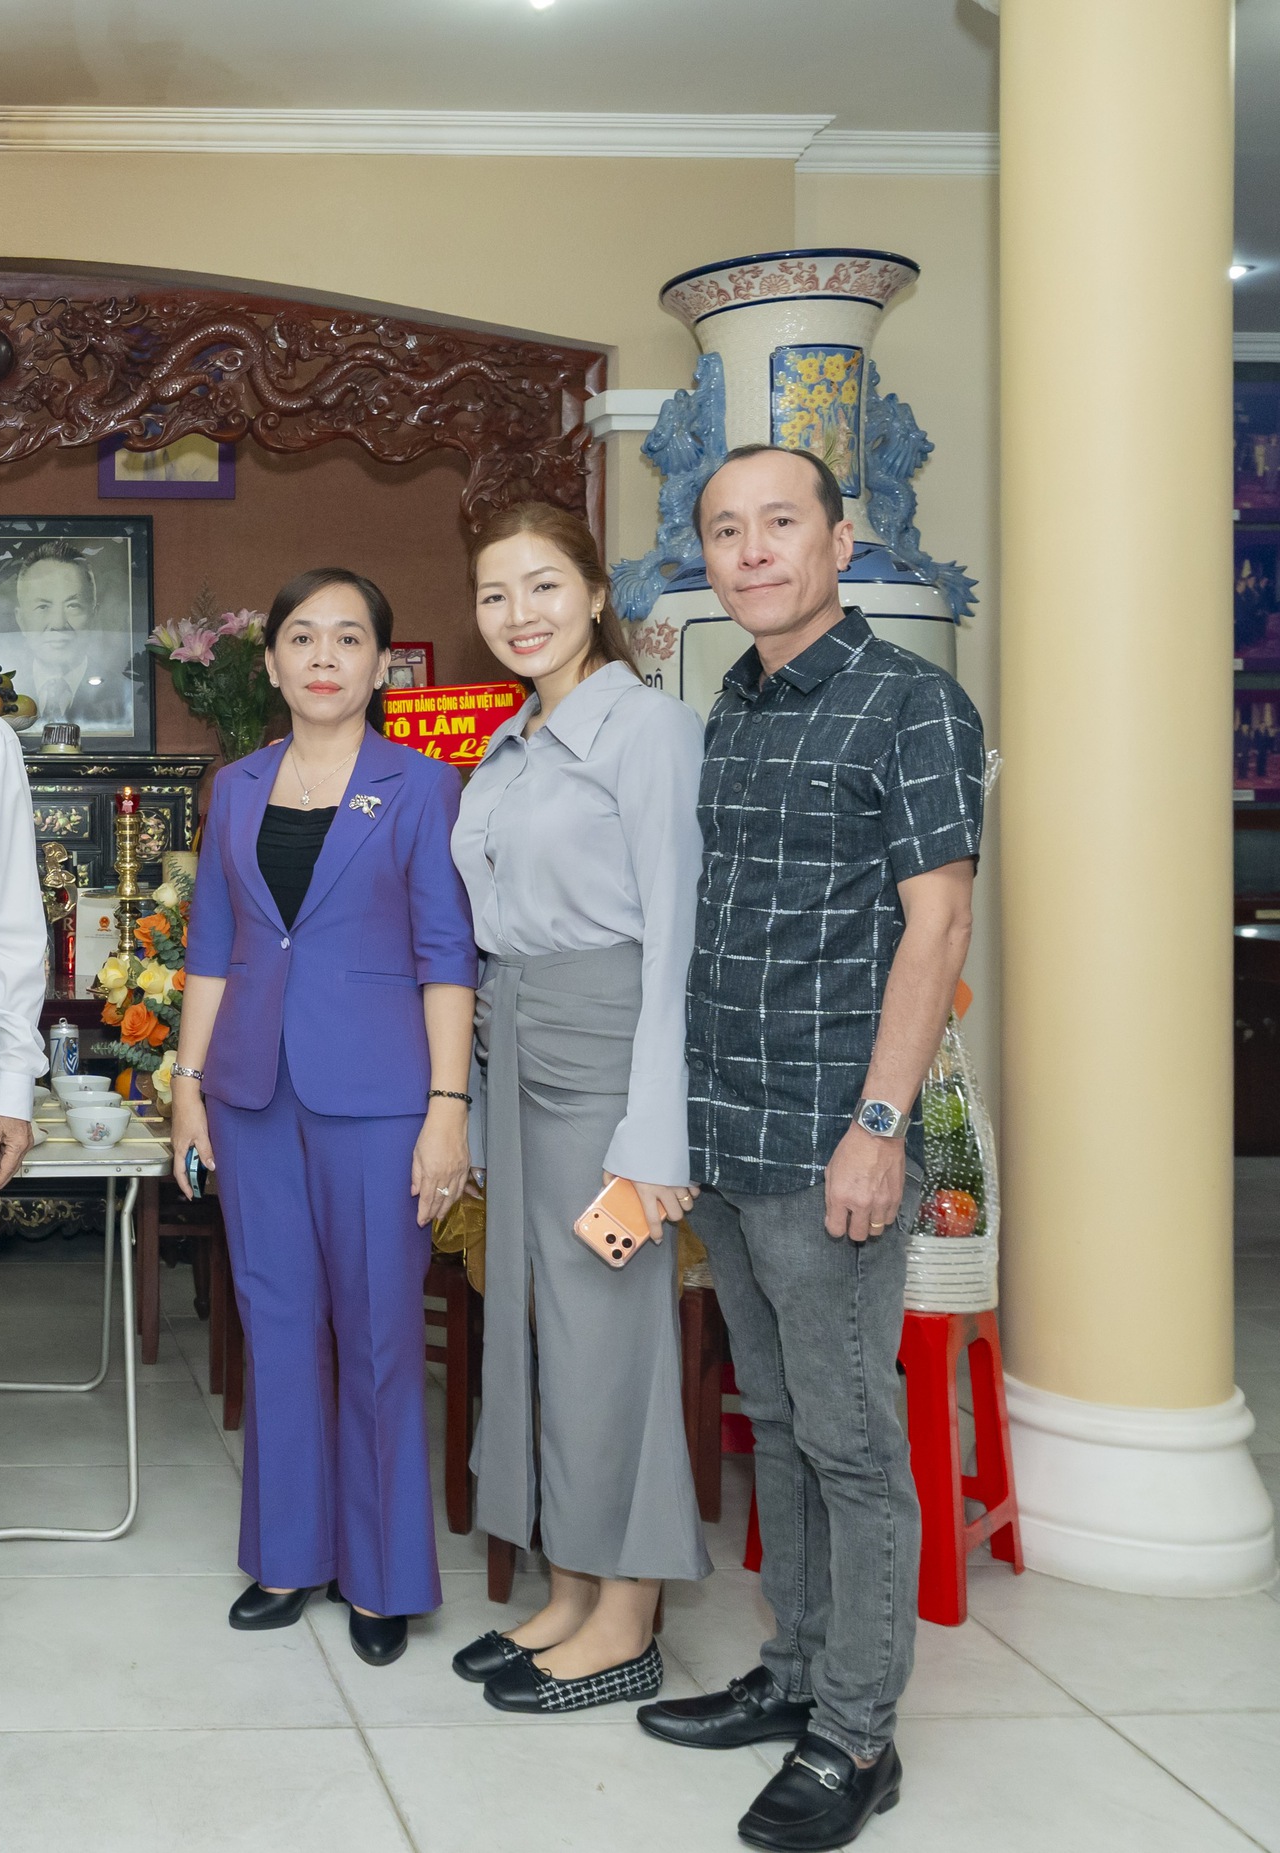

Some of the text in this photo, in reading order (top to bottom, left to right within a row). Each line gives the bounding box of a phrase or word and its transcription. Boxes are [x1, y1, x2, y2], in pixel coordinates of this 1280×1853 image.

[387, 699, 413, 714] BCHTW
[415, 694, 436, 712] ĐẢNG
[437, 694, 458, 714] CỘNG
[459, 691, 475, 709] SẢN
[476, 691, 493, 711] VIỆT
[495, 693, 513, 707] NAM
[383, 714, 476, 738] TÔ LÂM
